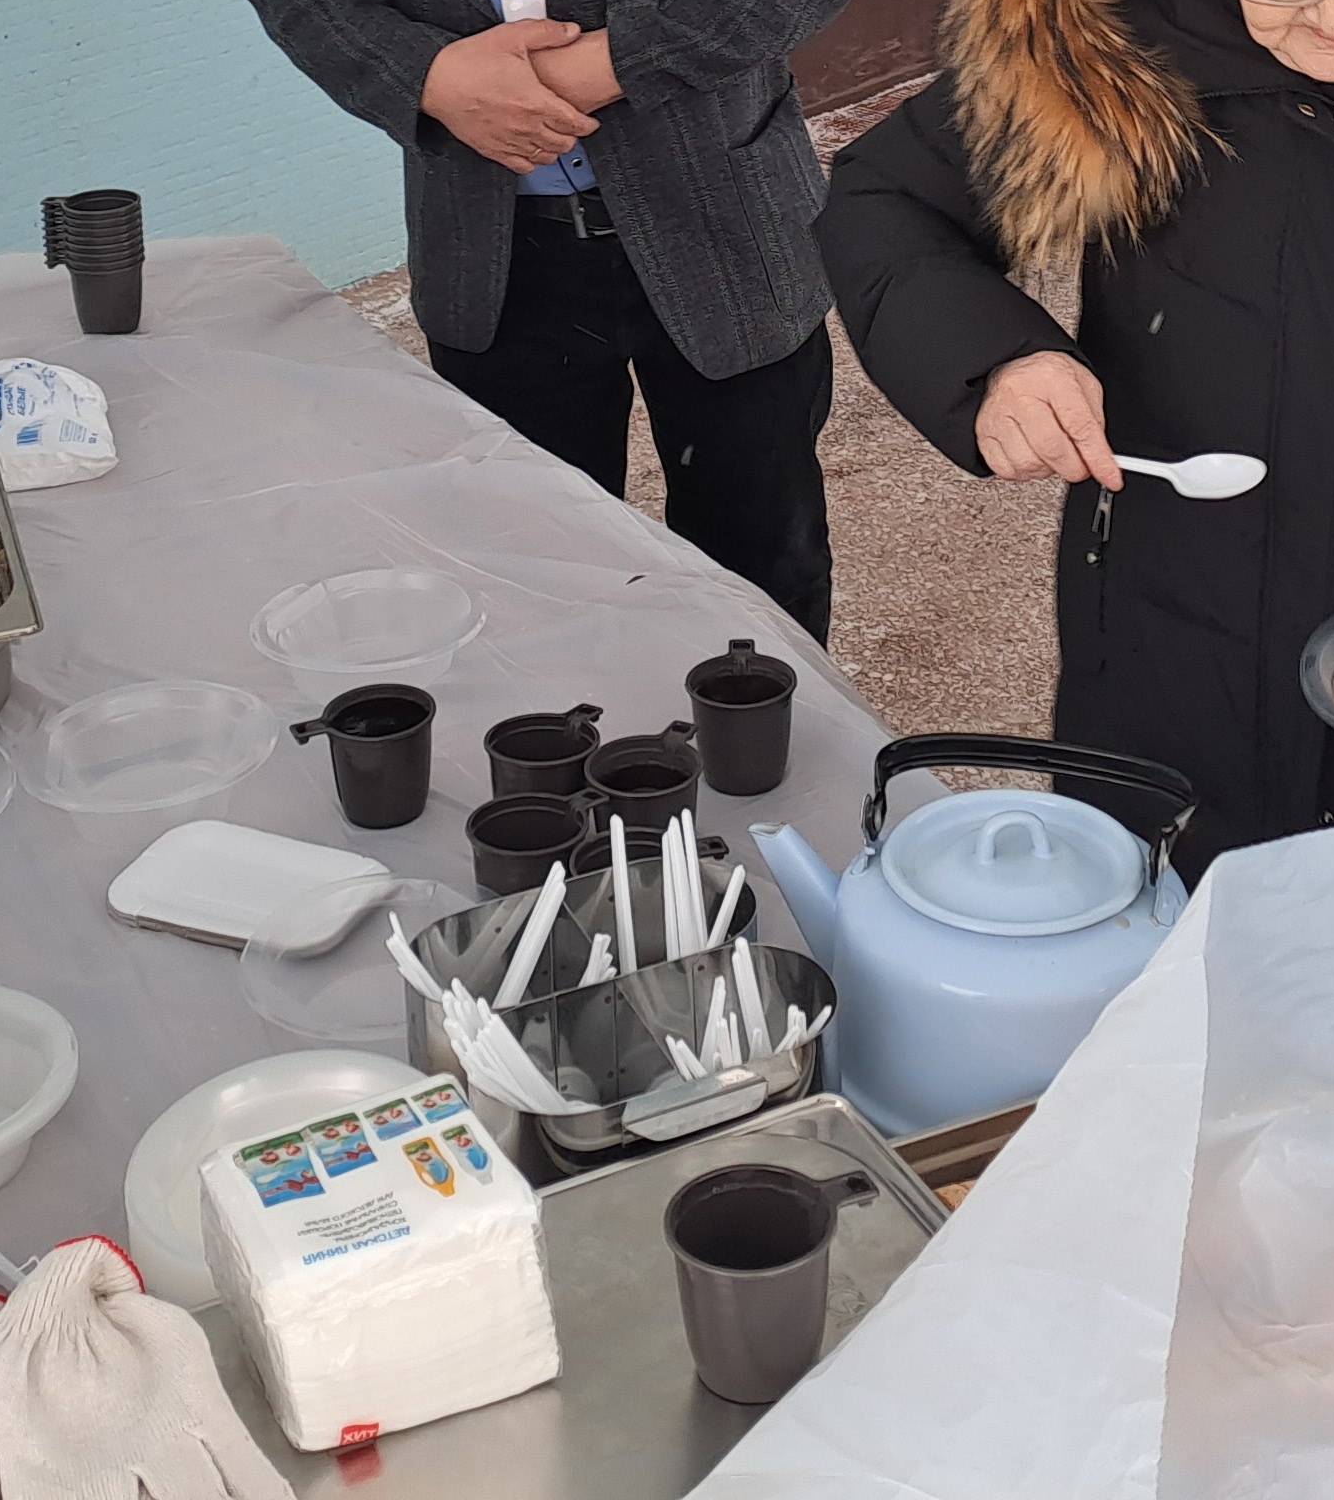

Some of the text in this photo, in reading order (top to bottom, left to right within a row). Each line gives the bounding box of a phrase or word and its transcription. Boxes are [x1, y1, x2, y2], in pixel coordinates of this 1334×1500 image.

[302, 1225, 411, 1266] ДЕТСКАЯ ЛИНИЯ
[341, 1429, 378, 1446] ХИТ
